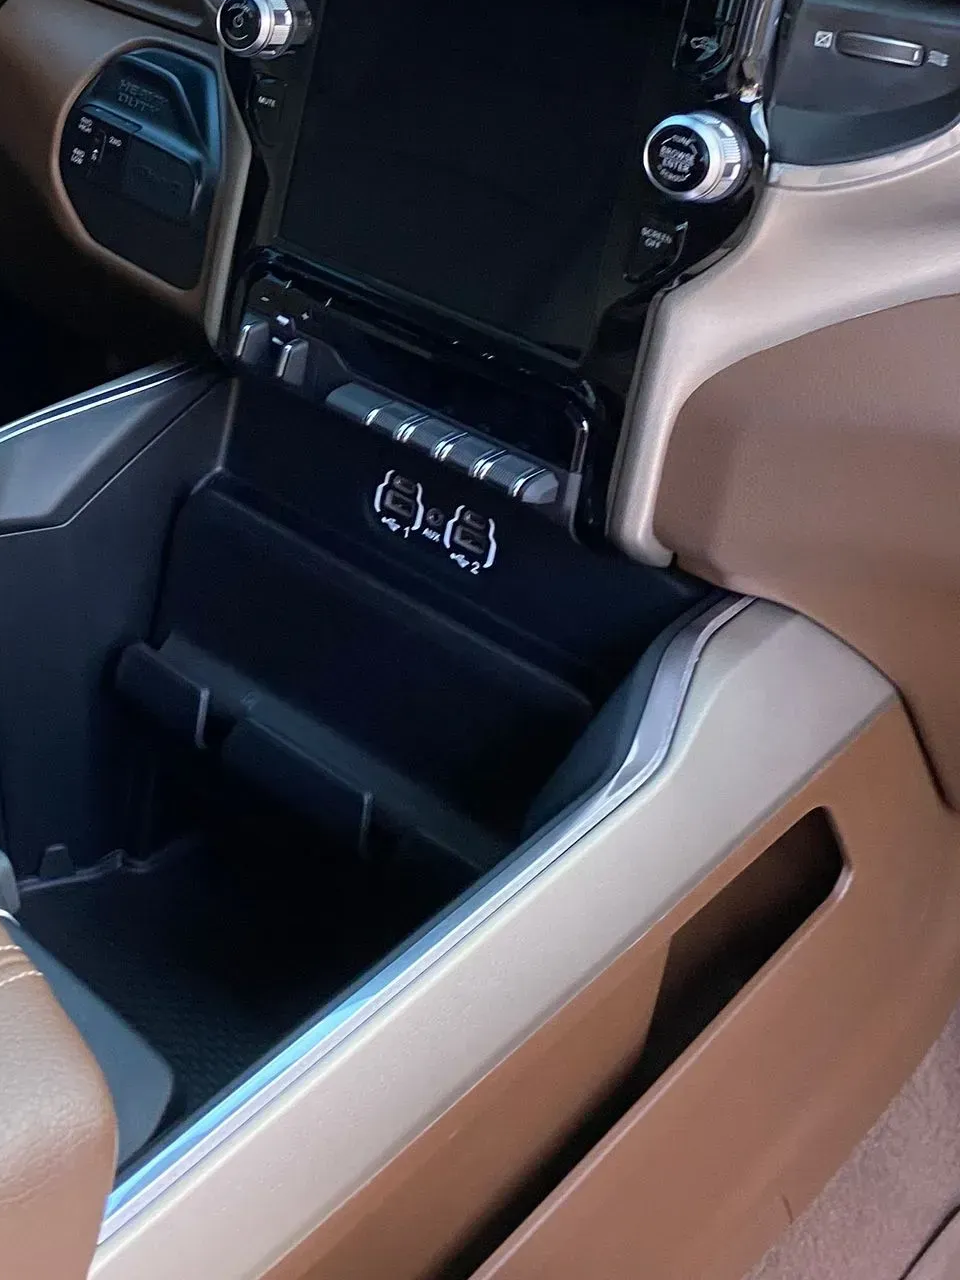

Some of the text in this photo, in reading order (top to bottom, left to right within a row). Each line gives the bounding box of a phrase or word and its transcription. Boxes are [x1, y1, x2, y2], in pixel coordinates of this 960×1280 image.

[641, 226, 673, 244] SCREEN
[403, 526, 411, 538] 1
[470, 561, 480, 575] 2
